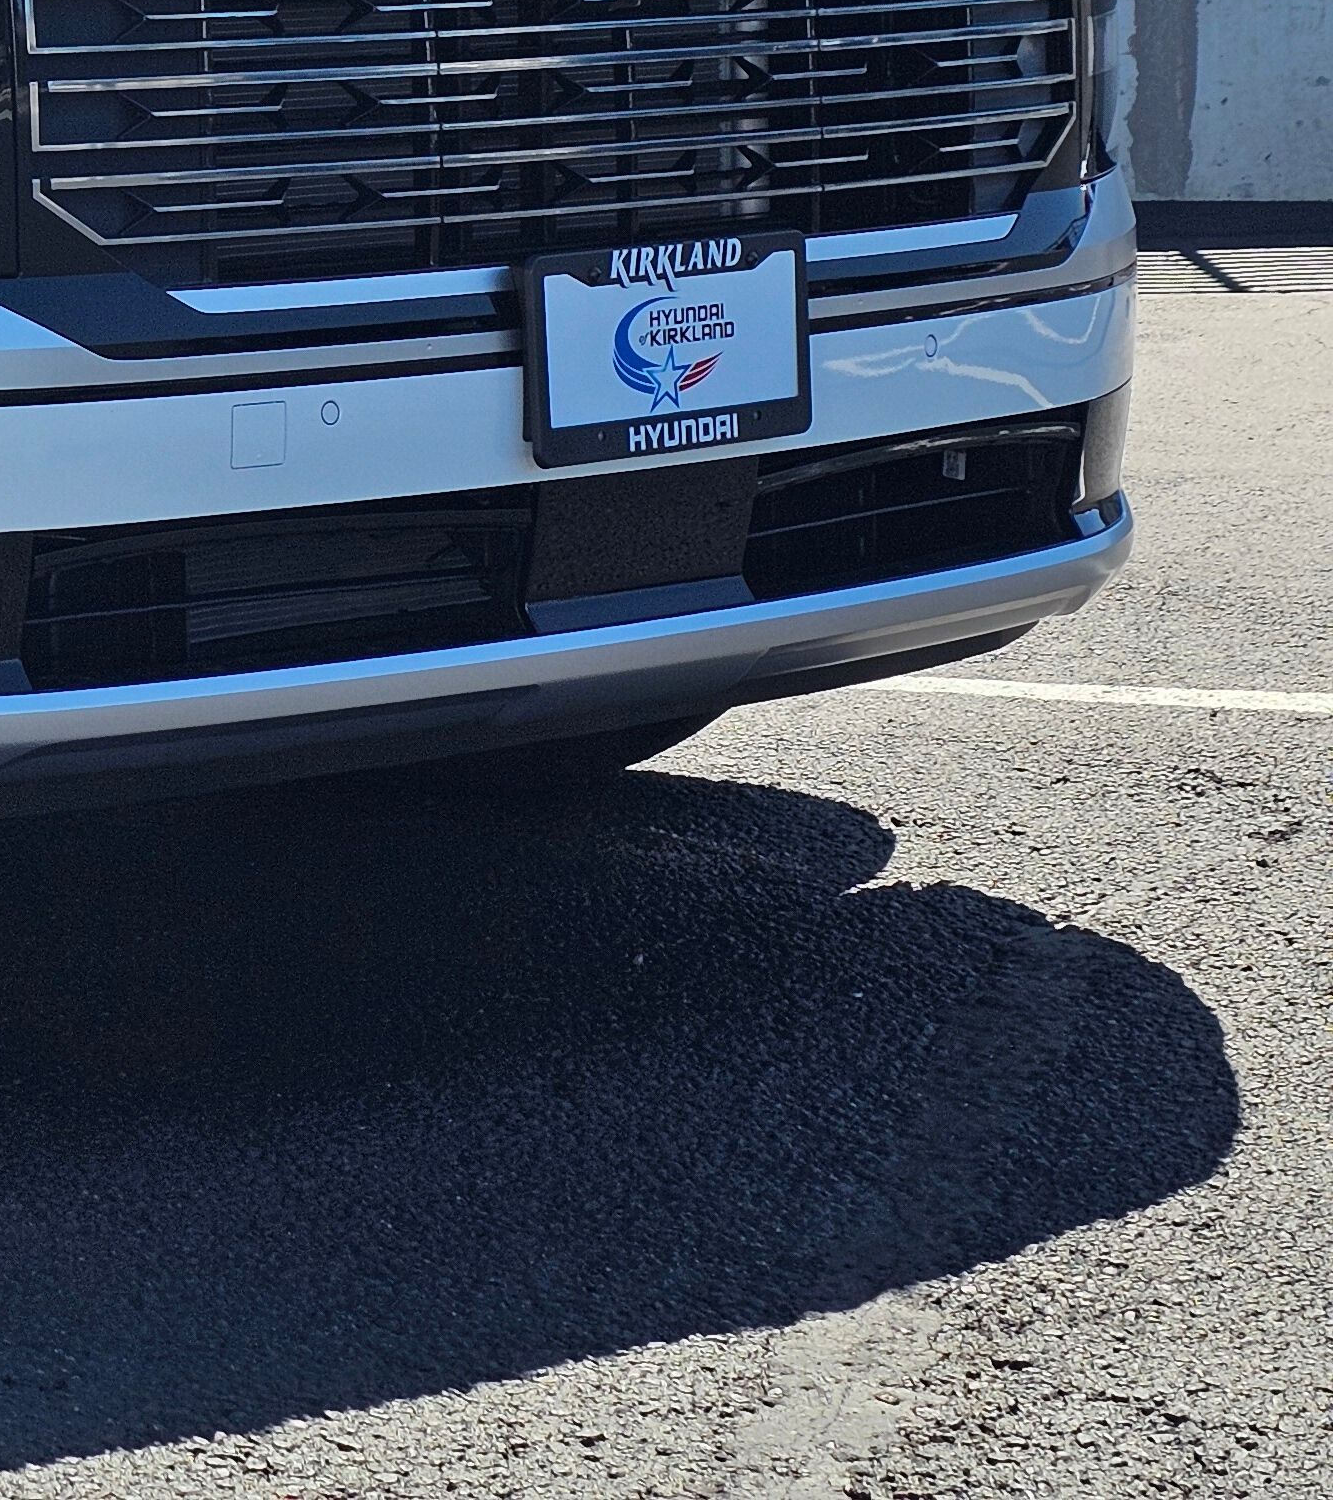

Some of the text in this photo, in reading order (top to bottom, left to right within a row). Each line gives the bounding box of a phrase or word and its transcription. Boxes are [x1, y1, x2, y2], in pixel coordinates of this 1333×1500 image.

[610, 237, 742, 292] KIRKLAND
[649, 302, 725, 328] HYUNDAI
[649, 321, 735, 347] KIRKLAND
[629, 412, 739, 452] HYUNDAI
